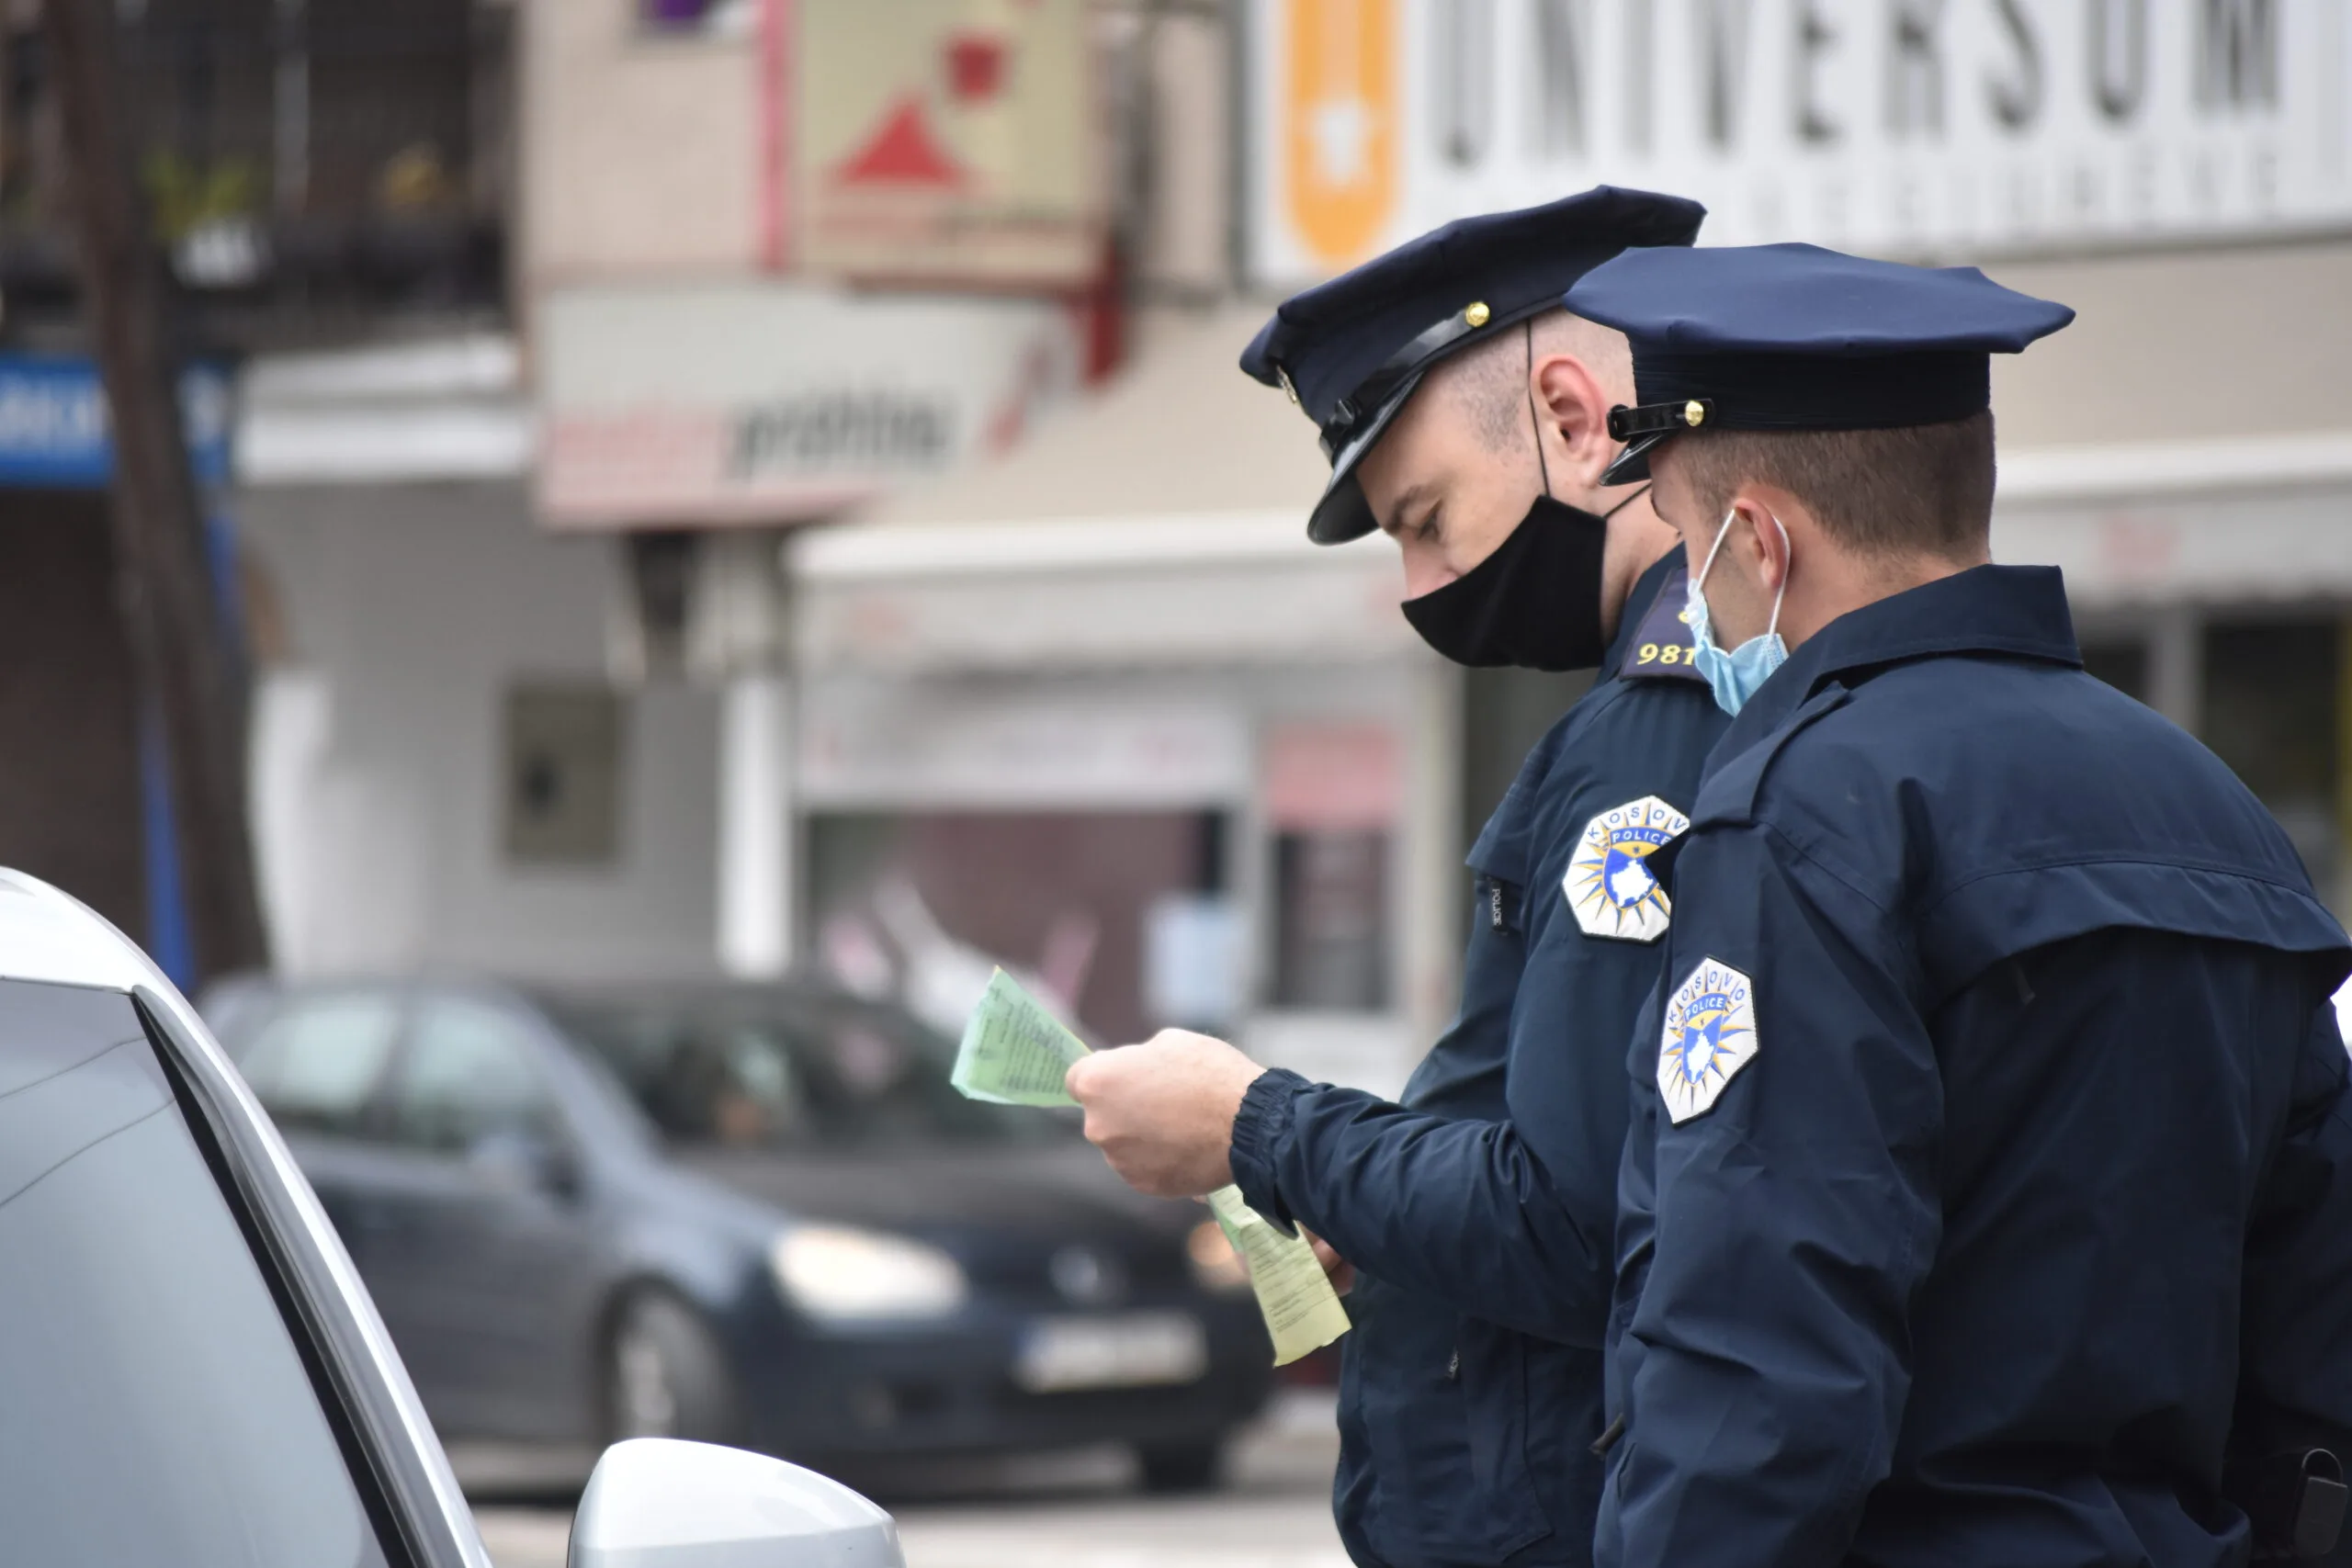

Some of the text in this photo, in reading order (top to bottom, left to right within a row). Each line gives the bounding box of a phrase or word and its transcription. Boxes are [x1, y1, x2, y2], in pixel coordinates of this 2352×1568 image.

[1588, 807, 1687, 839] KOSOV
[1612, 830, 1671, 845] POLICE
[1492, 888, 1502, 926] POLICE
[1668, 971, 1745, 1022] KOSOVO
[1685, 998, 1724, 1021] POLICE
